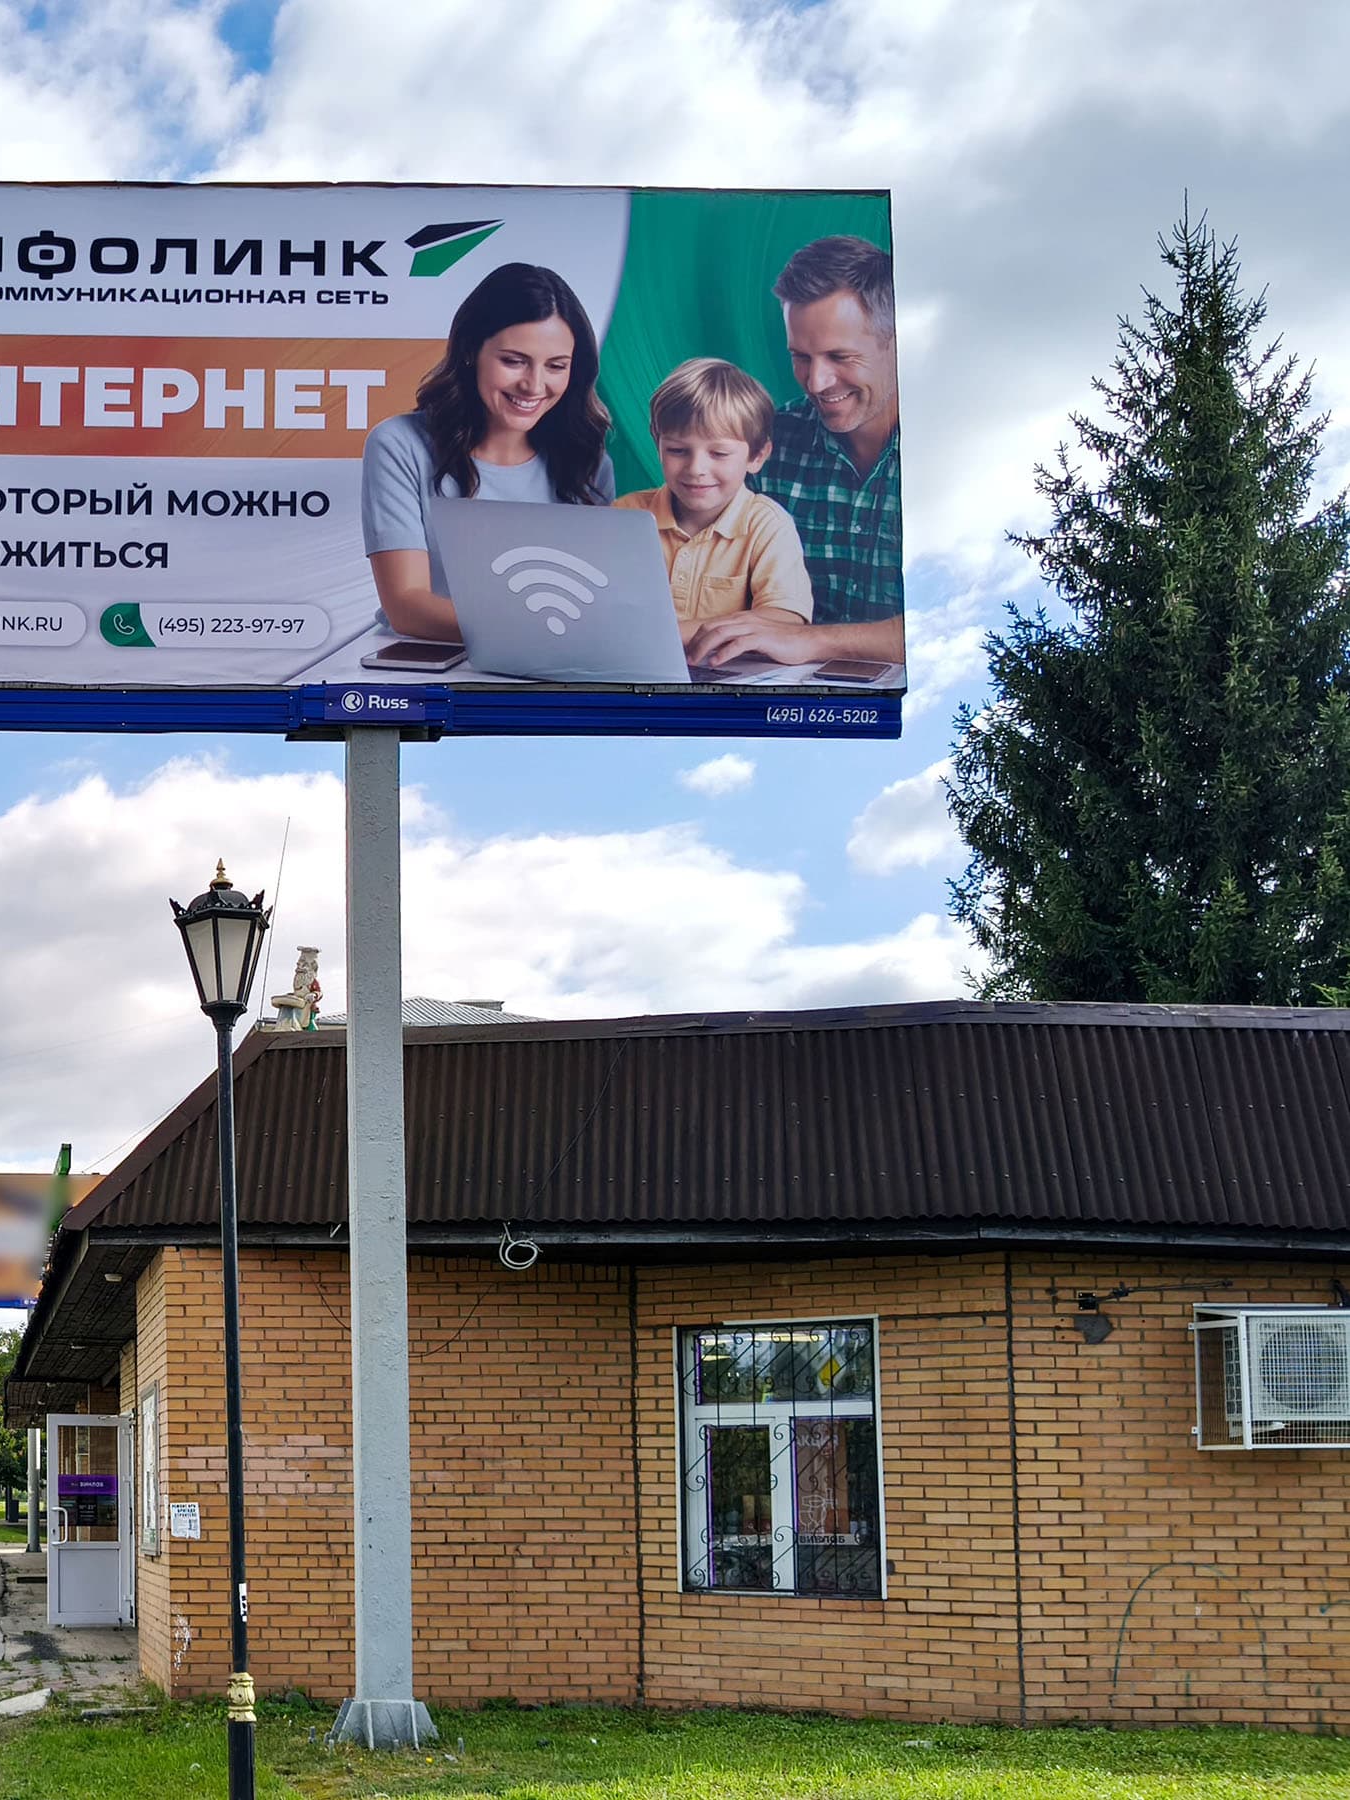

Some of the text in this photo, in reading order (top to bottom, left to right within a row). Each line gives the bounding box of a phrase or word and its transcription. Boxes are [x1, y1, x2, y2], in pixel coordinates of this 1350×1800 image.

[316, 290, 389, 305] СЕТЬ
[167, 489, 331, 518] МОЖНО
[158, 616, 305, 637] (495) 223-97-97
[368, 694, 409, 709] Russ
[766, 706, 878, 724] (495) 626-5202
